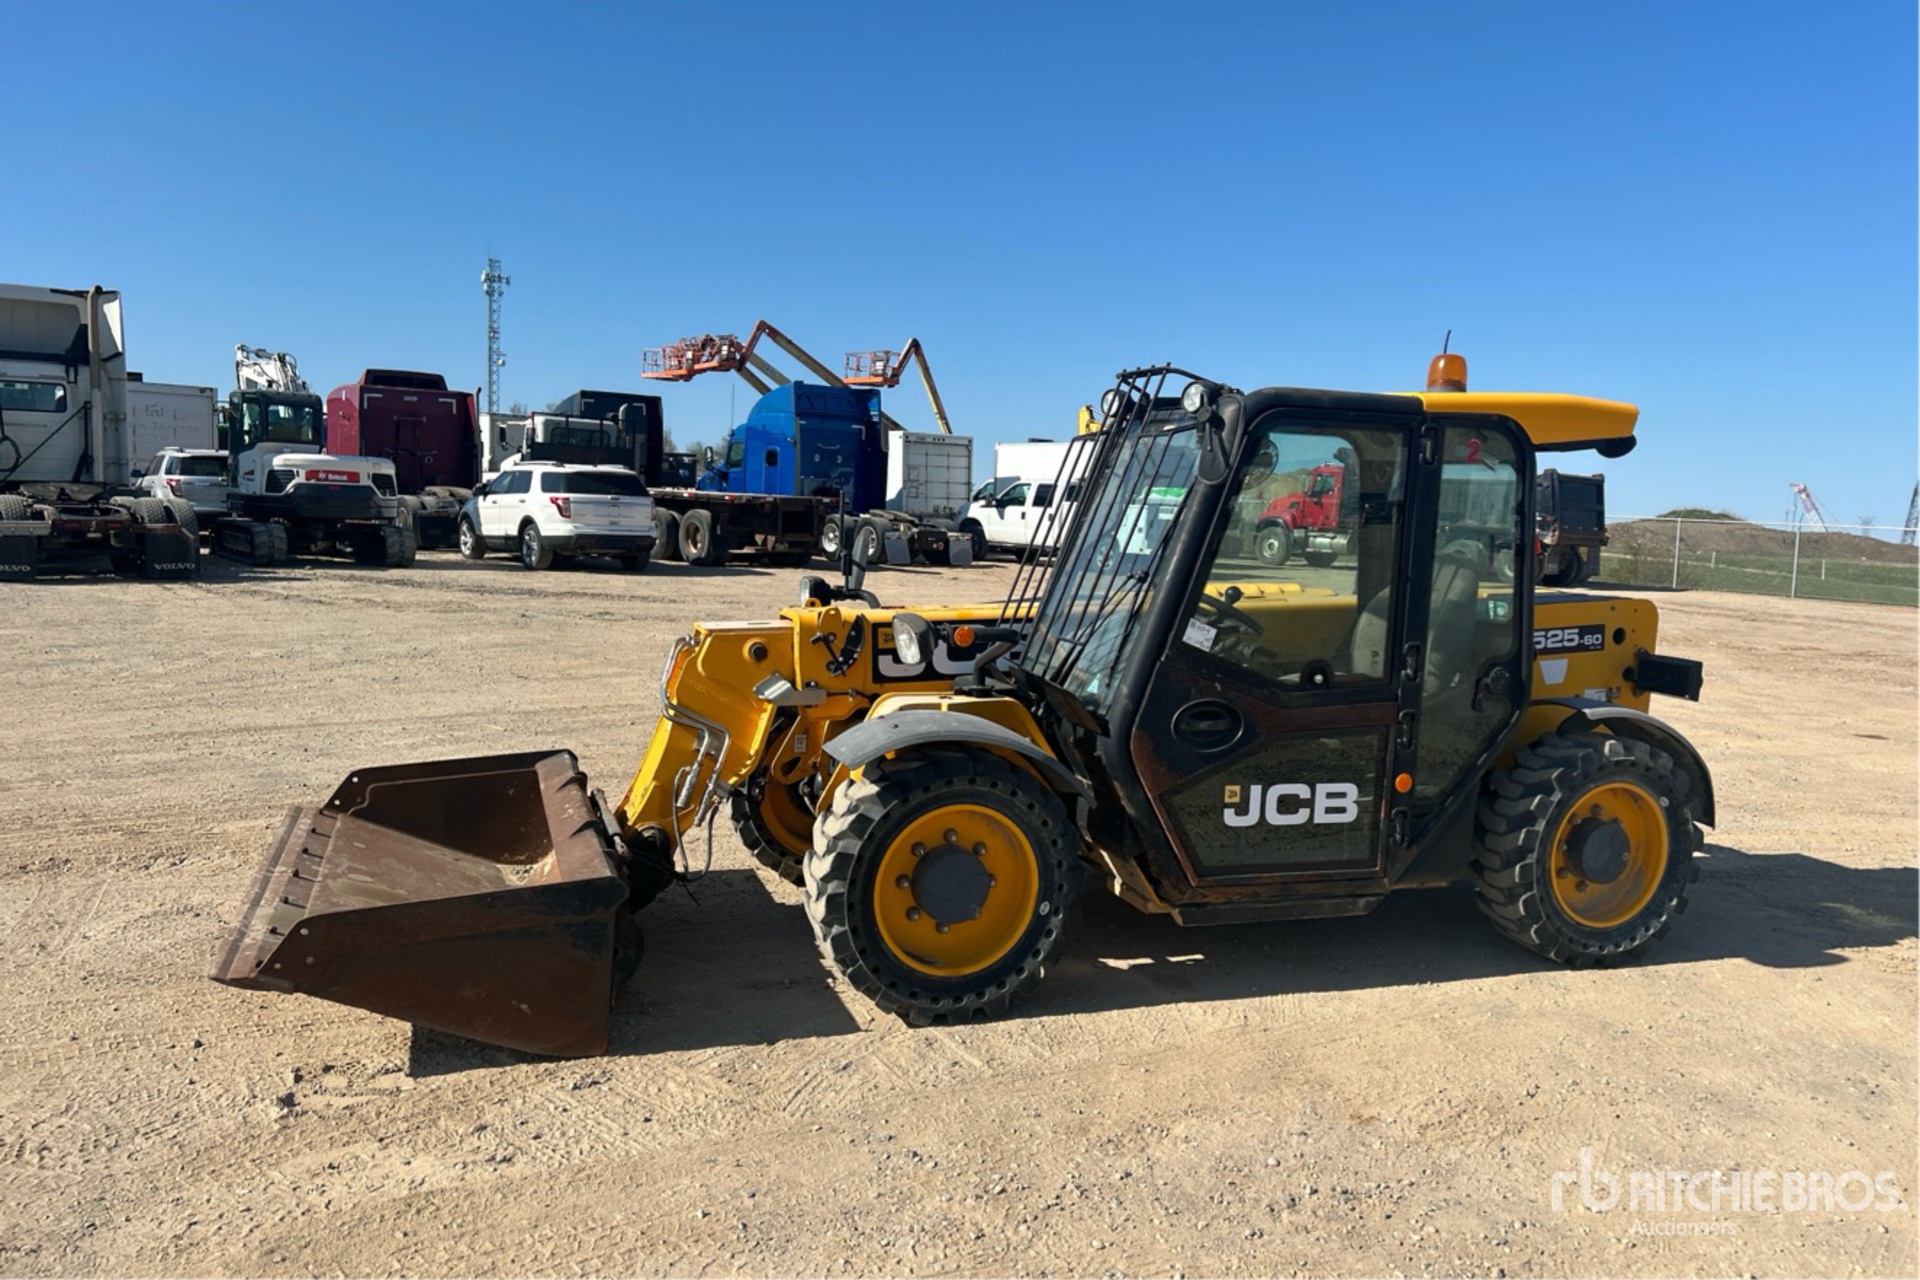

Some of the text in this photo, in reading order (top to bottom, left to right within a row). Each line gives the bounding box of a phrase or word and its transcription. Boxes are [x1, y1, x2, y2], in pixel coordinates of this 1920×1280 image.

[1465, 438, 1482, 463] 2
[154, 562, 195, 570] VOLVO
[1223, 782, 1358, 827] JCB
